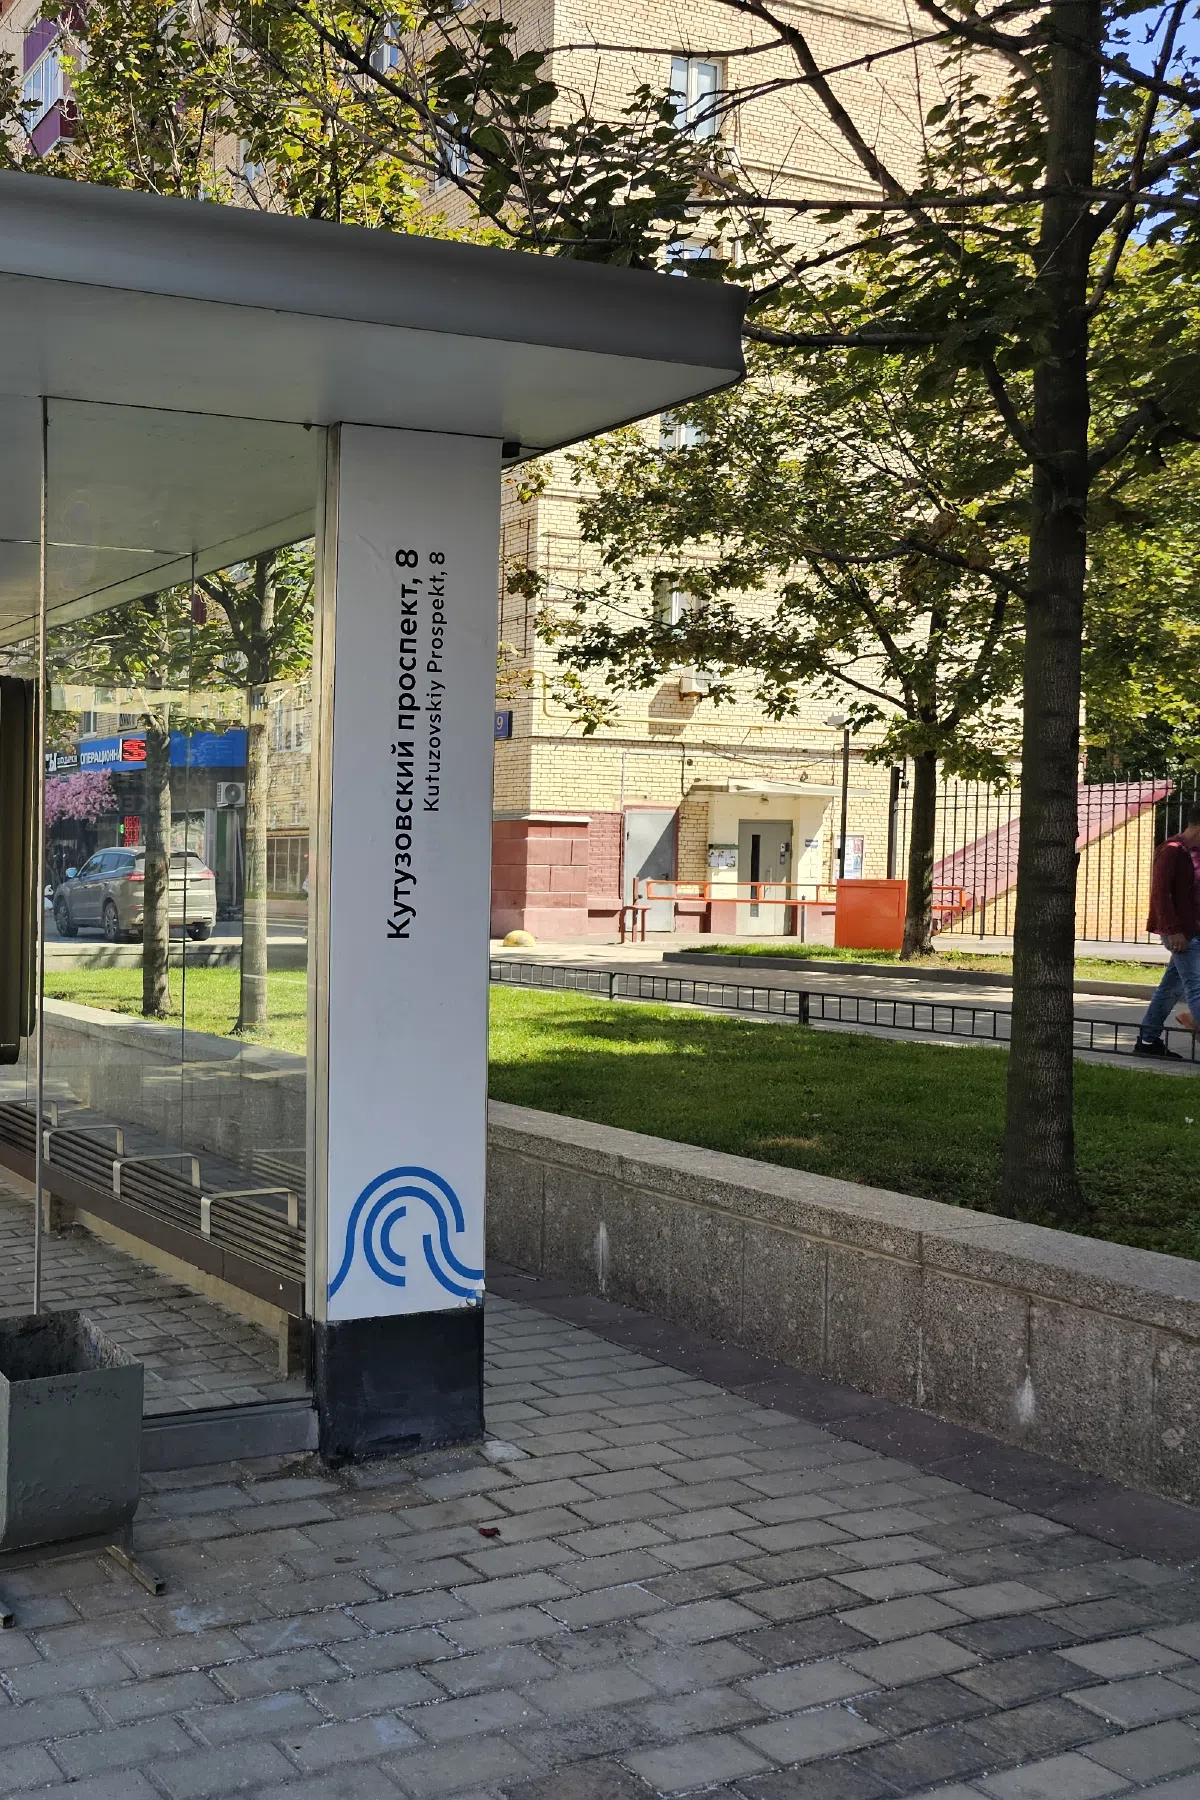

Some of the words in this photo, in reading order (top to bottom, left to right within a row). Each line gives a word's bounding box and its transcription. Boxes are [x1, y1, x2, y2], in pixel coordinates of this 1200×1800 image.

[395, 548, 419, 569] 8
[429, 551, 446, 565] 8
[395, 577, 423, 730] проспект,
[426, 570, 448, 674] Prospekt,
[422, 680, 446, 812] Kutuzovskiy
[386, 741, 417, 939] Кутузовский
